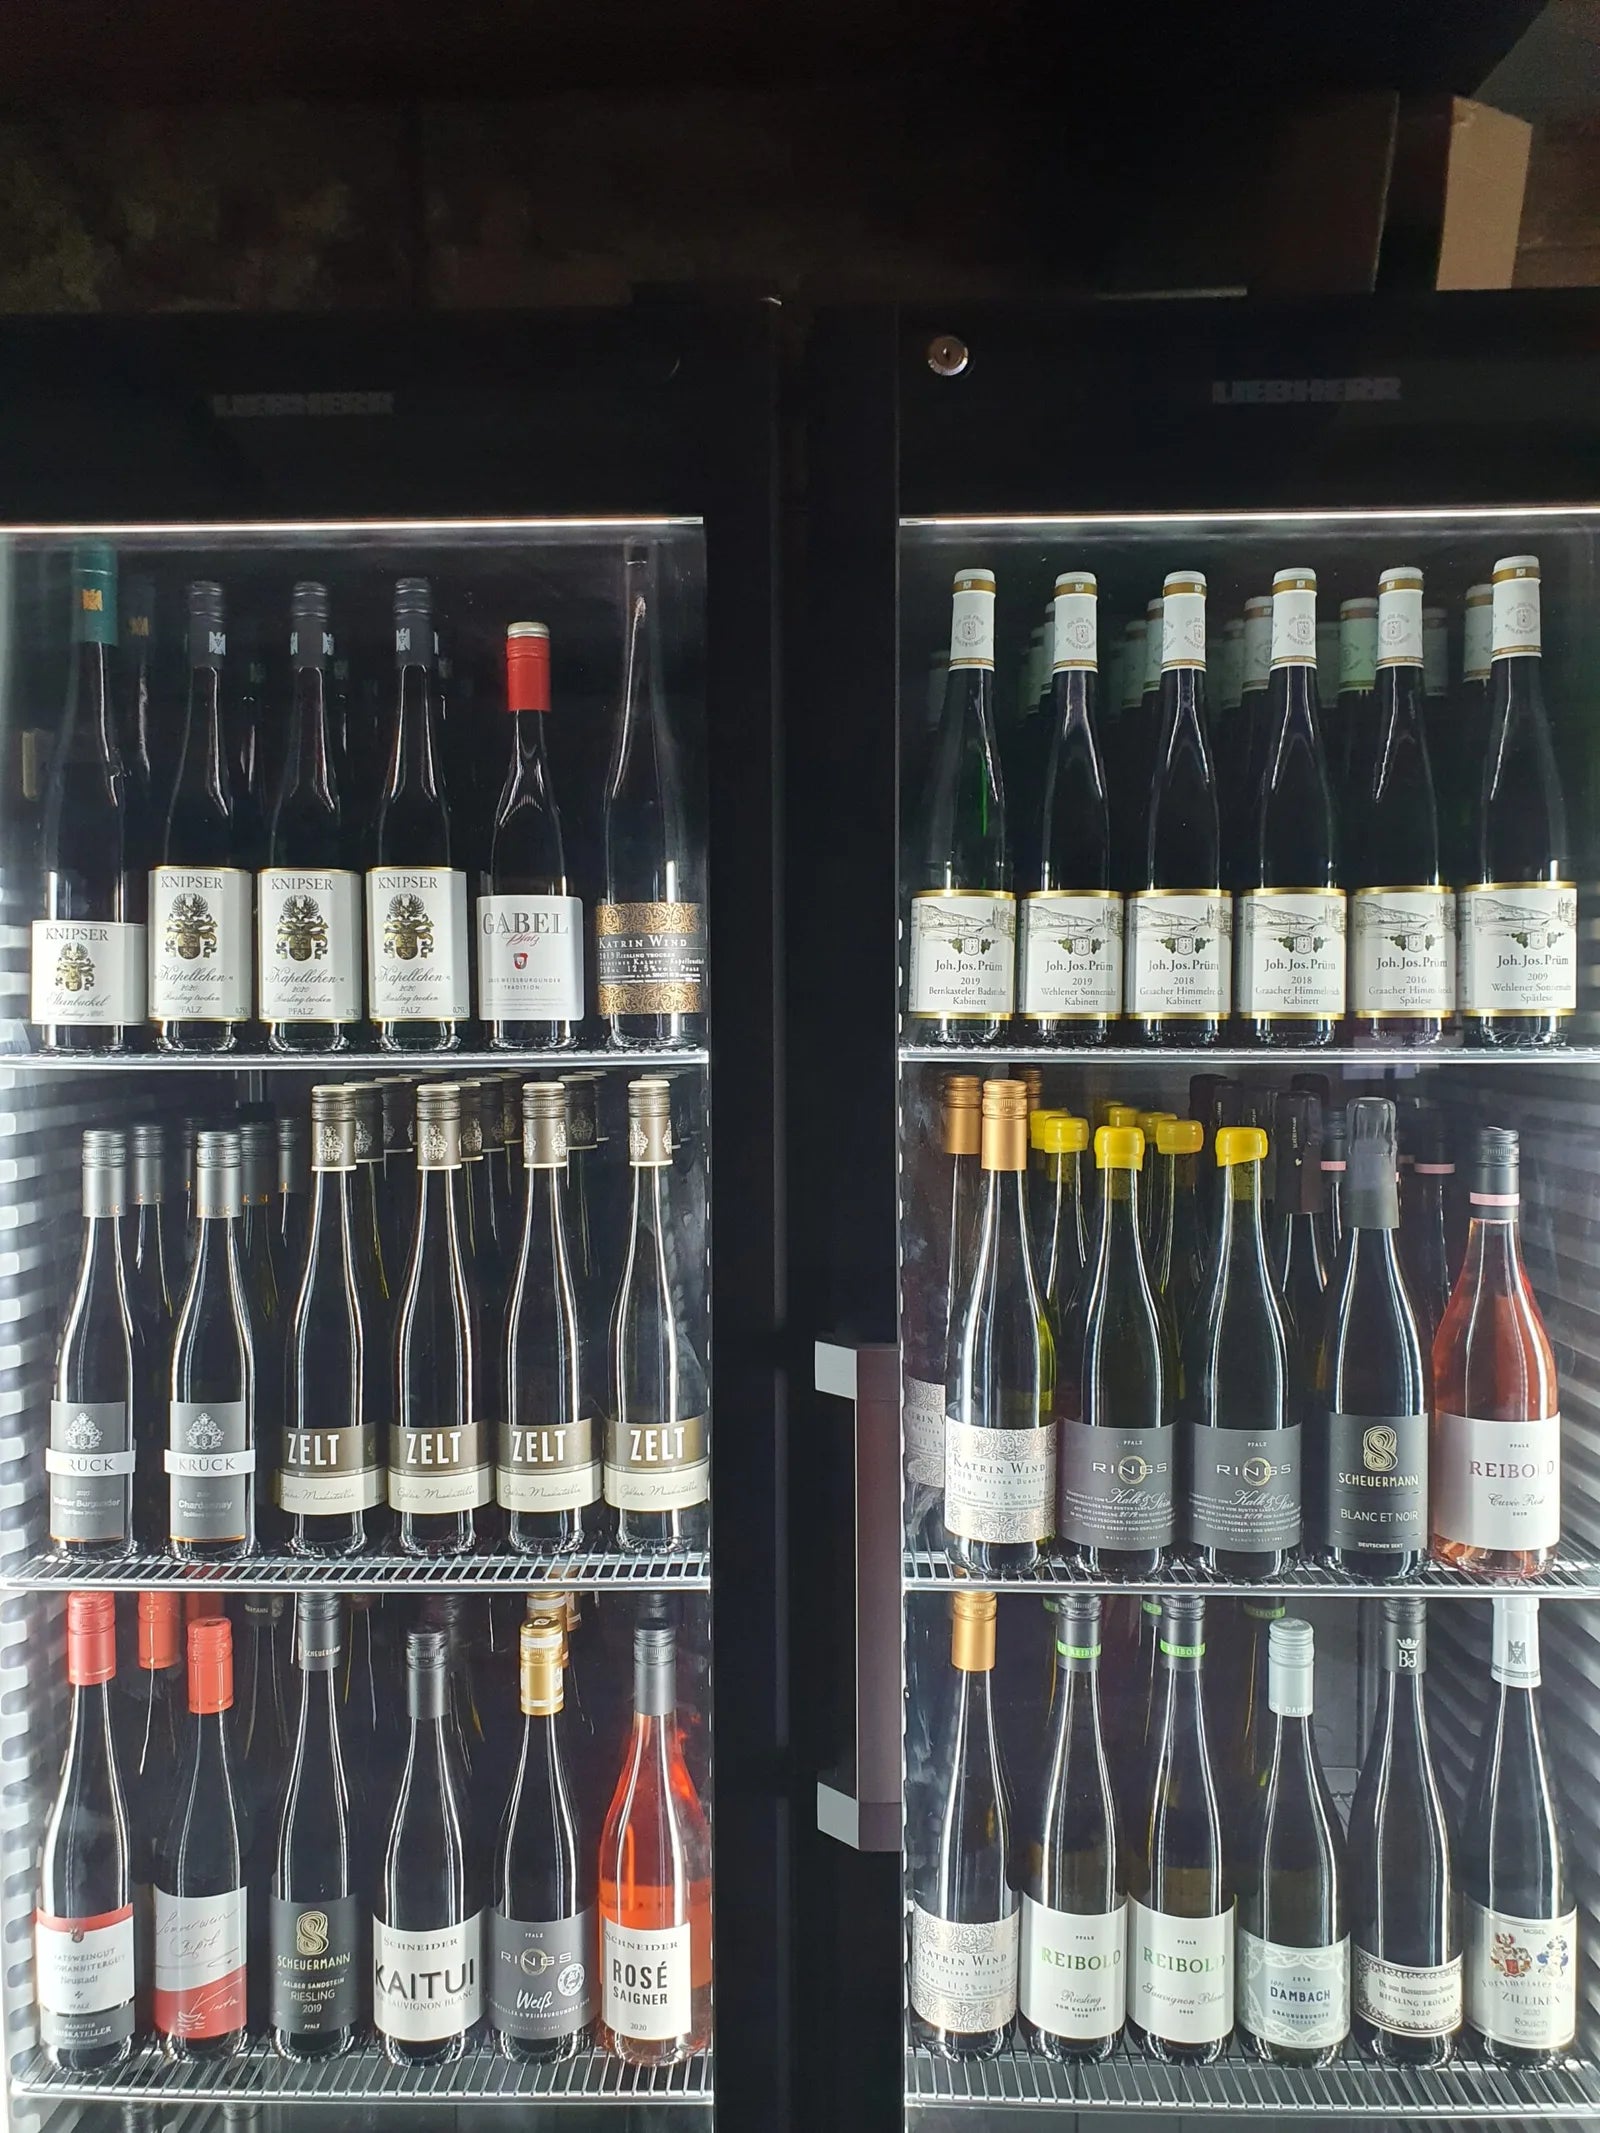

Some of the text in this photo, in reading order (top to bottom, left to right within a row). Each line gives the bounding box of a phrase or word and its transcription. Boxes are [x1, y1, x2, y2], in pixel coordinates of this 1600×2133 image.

[161, 876, 224, 890] KNIPSER
[271, 878, 334, 891] KNIPSER
[377, 876, 439, 890] KNIPSER
[482, 912, 569, 936] GABEL
[45, 928, 109, 942] KNIPSER
[598, 934, 688, 950] KATRIN WIND
[935, 960, 956, 971] Joh.
[956, 960, 977, 972] Jos.
[1045, 961, 1066, 973] Joh.
[1067, 961, 1088, 973] Jos.
[1148, 960, 1168, 972] Joh.
[1169, 960, 1190, 972] Jos.
[1264, 959, 1287, 971] Joh.
[1287, 959, 1308, 971] Jos.
[1375, 956, 1399, 970] Joh.
[1400, 957, 1421, 970] Jos.
[1496, 954, 1569, 968] Joh. Jos. Prüm
[960, 977, 981, 986] 2019
[1072, 977, 1093, 986] 2019
[1173, 976, 1195, 985] 2018
[1291, 976, 1312, 985] 2018
[1491, 983, 1533, 992] Wehlener
[928, 986, 975, 995] Bernkasteler
[1041, 986, 1078, 996] Wehlener
[1368, 986, 1406, 996] Graacher
[952, 996, 987, 1006] Kabinett
[1064, 997, 1099, 1006] Kabinett
[1165, 996, 1202, 1005] Kabinett
[1283, 995, 1319, 1005] Kabinett
[1399, 996, 1432, 1007] Spätlese
[1520, 993, 1553, 1004] Spätlese
[287, 1433, 340, 1466] ZELT
[406, 1431, 463, 1465] ZELT
[511, 1429, 567, 1463] ZELT
[630, 1427, 686, 1462] ZELT
[68, 1456, 115, 1472] RÜCK
[178, 1456, 237, 1471] KRÜCK
[1010, 1462, 1046, 1475] WIND
[1091, 1462, 1168, 1475] RINGS
[1216, 1463, 1292, 1476] RINGS
[1338, 1471, 1419, 1488] SCHEUERMANN
[1340, 1508, 1419, 1523] BLANC ET NOIR
[384, 1936, 458, 1952] SCHNEIDER
[604, 1931, 680, 1953] SCHNEIDER
[54, 1947, 116, 1962] ATSWEINGUT
[277, 1951, 351, 1971] SCHEUERMANN
[500, 1950, 572, 1967] RINGS
[972, 1954, 1007, 1967] WIND
[1040, 1946, 1122, 1972] REIBOLD
[374, 1958, 474, 2001] KAITUI
[612, 1958, 668, 1990] ROSÉ
[290, 1987, 336, 2002] RIESLING
[613, 1987, 668, 2006] SAIGNER
[1060, 1989, 1103, 2007] Riesling
[1270, 1986, 1330, 2003] DAMBACH
[302, 2003, 323, 2014] 2019
[391, 1998, 443, 2012] AUVIGNON
